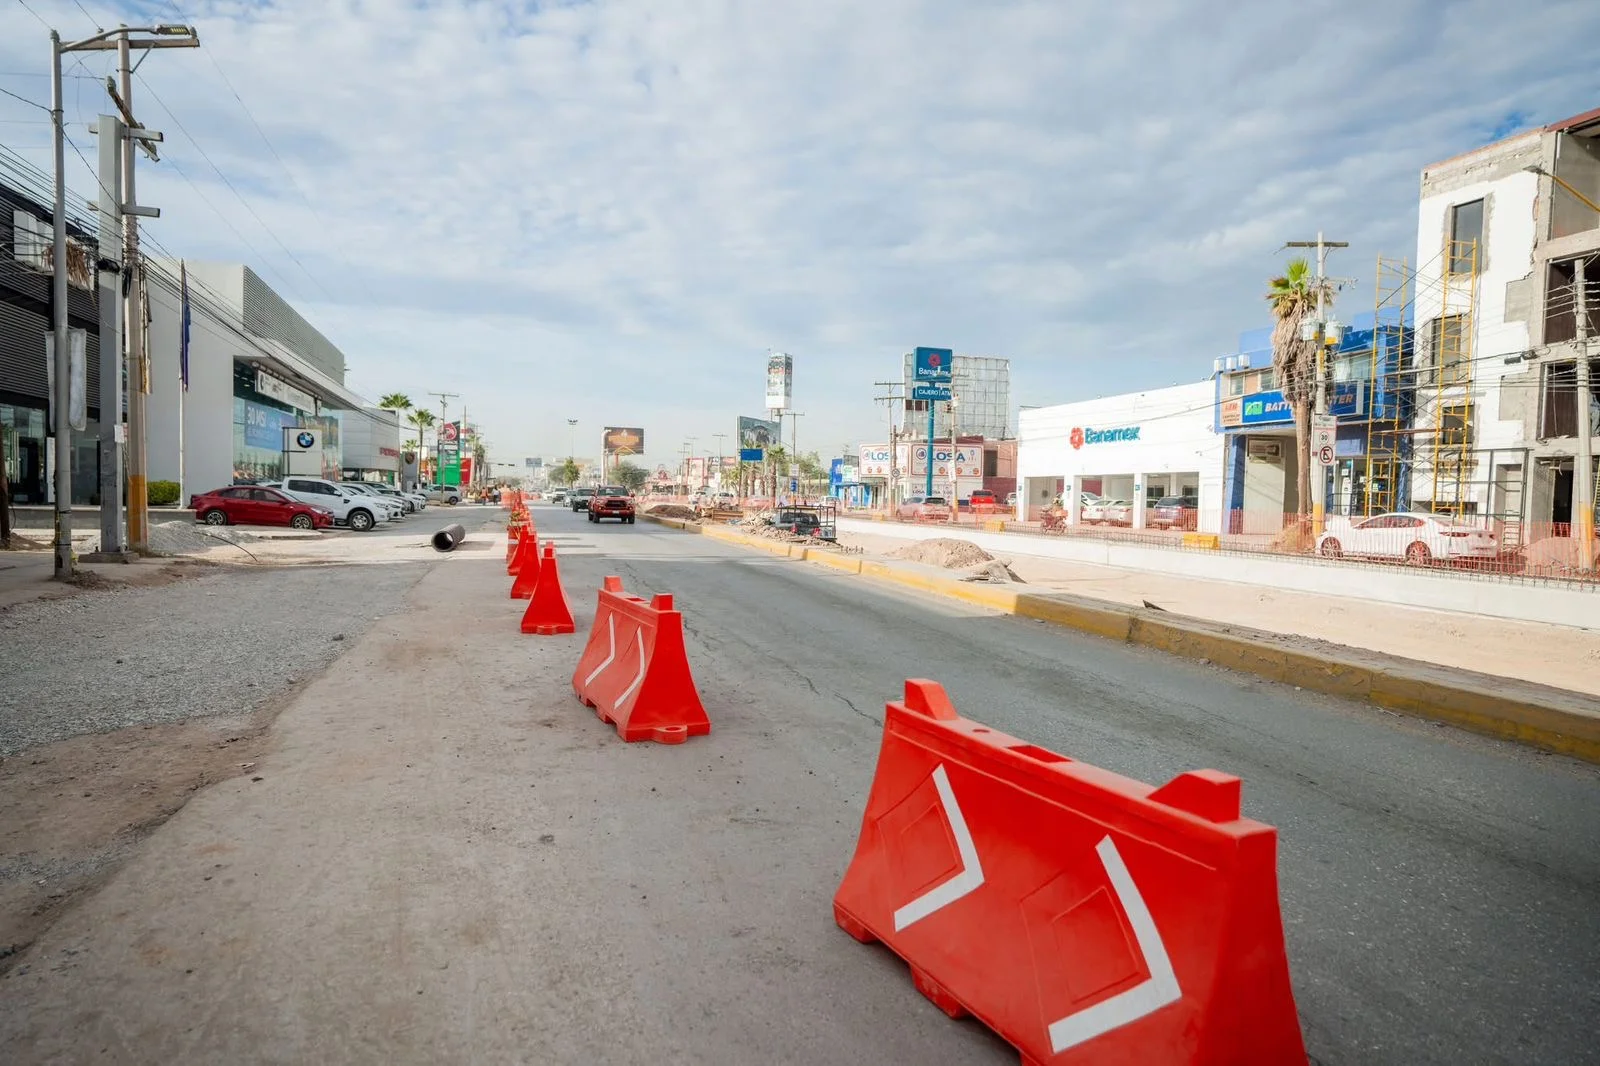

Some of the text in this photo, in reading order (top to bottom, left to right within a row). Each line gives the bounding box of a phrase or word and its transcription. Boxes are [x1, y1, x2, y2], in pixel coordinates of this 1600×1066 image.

[918, 367, 951, 377] Banaex
[1085, 427, 1141, 444] Banamex
[871, 451, 889, 461] LOS
